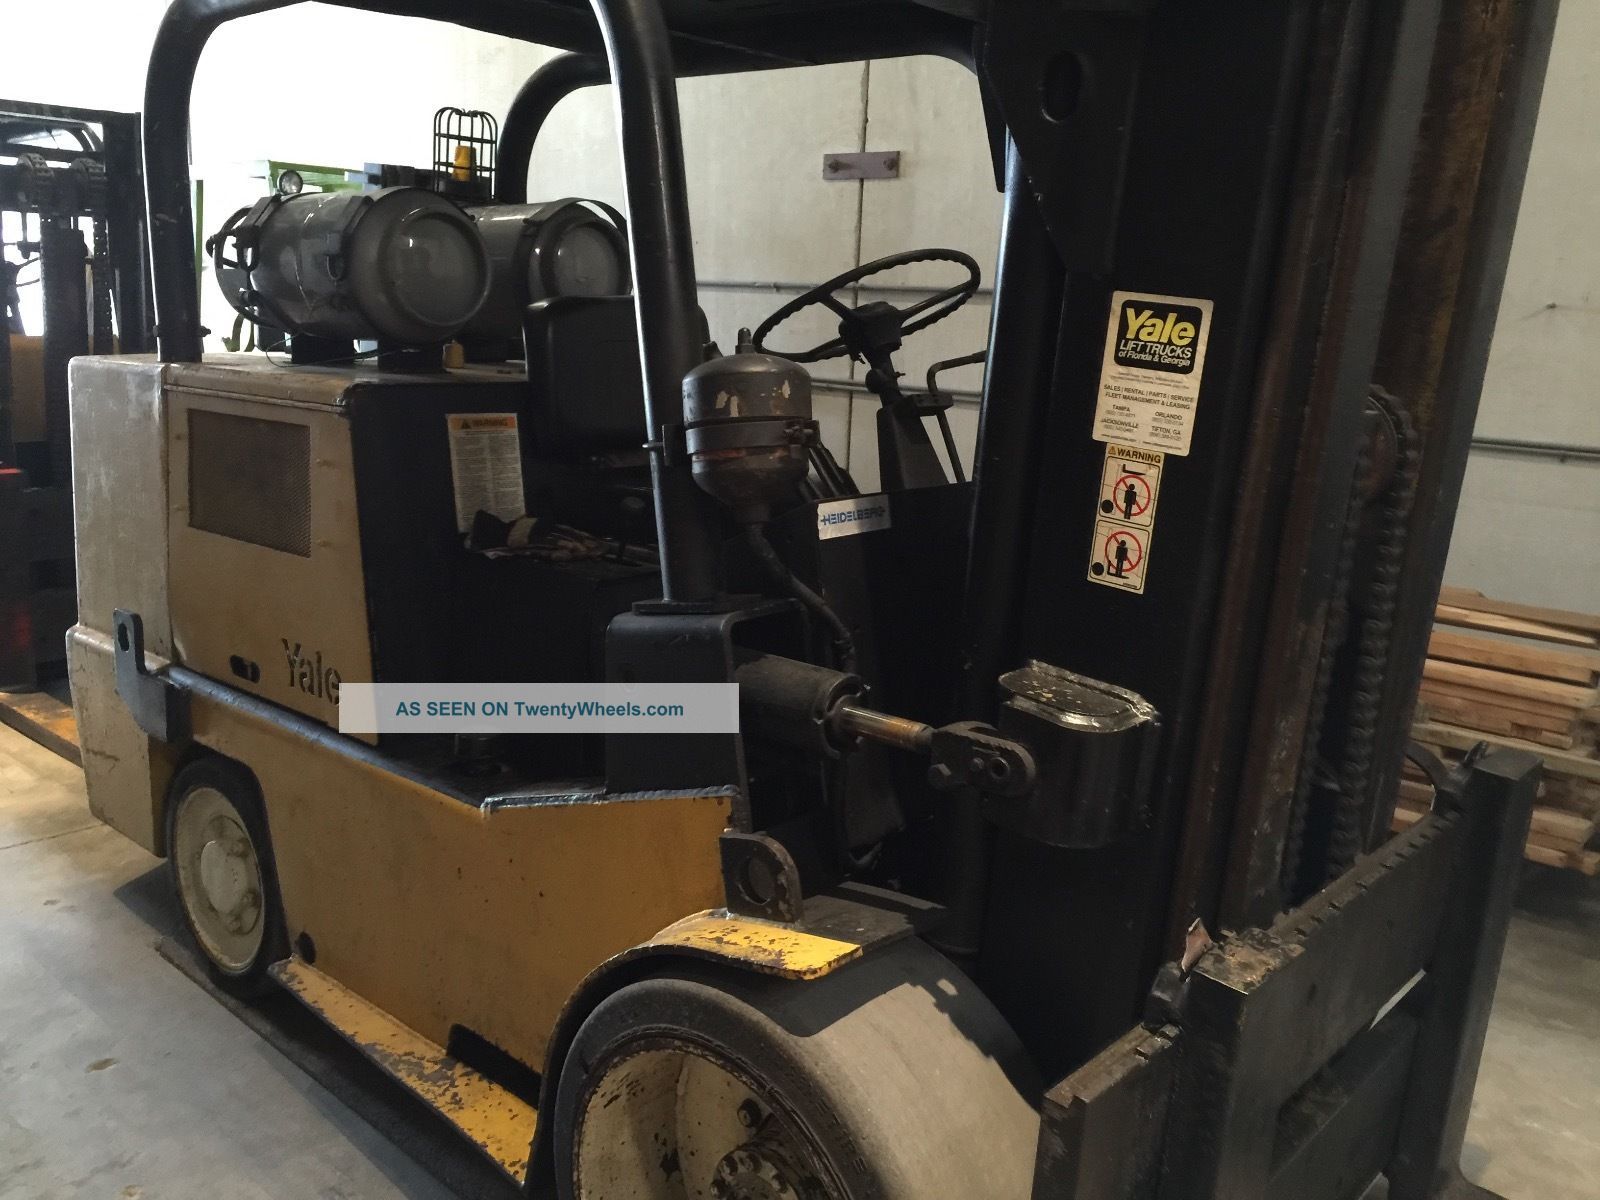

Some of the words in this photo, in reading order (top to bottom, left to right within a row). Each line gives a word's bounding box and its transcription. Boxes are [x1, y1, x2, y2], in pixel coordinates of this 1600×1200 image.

[1126, 308, 1195, 346] Yale
[1119, 339, 1145, 352] LIFT
[1145, 342, 1193, 359] TRUCKS
[1118, 350, 1127, 358] of
[1127, 350, 1152, 361] Florida
[1153, 354, 1160, 362] &
[1160, 355, 1191, 367] Georgia
[1103, 384, 1121, 392] SALES
[1124, 387, 1145, 396] RENTAL
[1148, 391, 1167, 399] PARTS
[1170, 395, 1195, 403] SERVICE
[1105, 392, 1122, 400] FLEET
[1122, 394, 1161, 405] MANAGEMENT
[1165, 402, 1191, 410] LEASING
[1112, 404, 1131, 412] TAMPA
[1154, 411, 1183, 421] ORLANDO
[1101, 418, 1139, 429] JACKSONVILLE
[1117, 448, 1162, 464] WARNING
[281, 637, 342, 706] Yale
